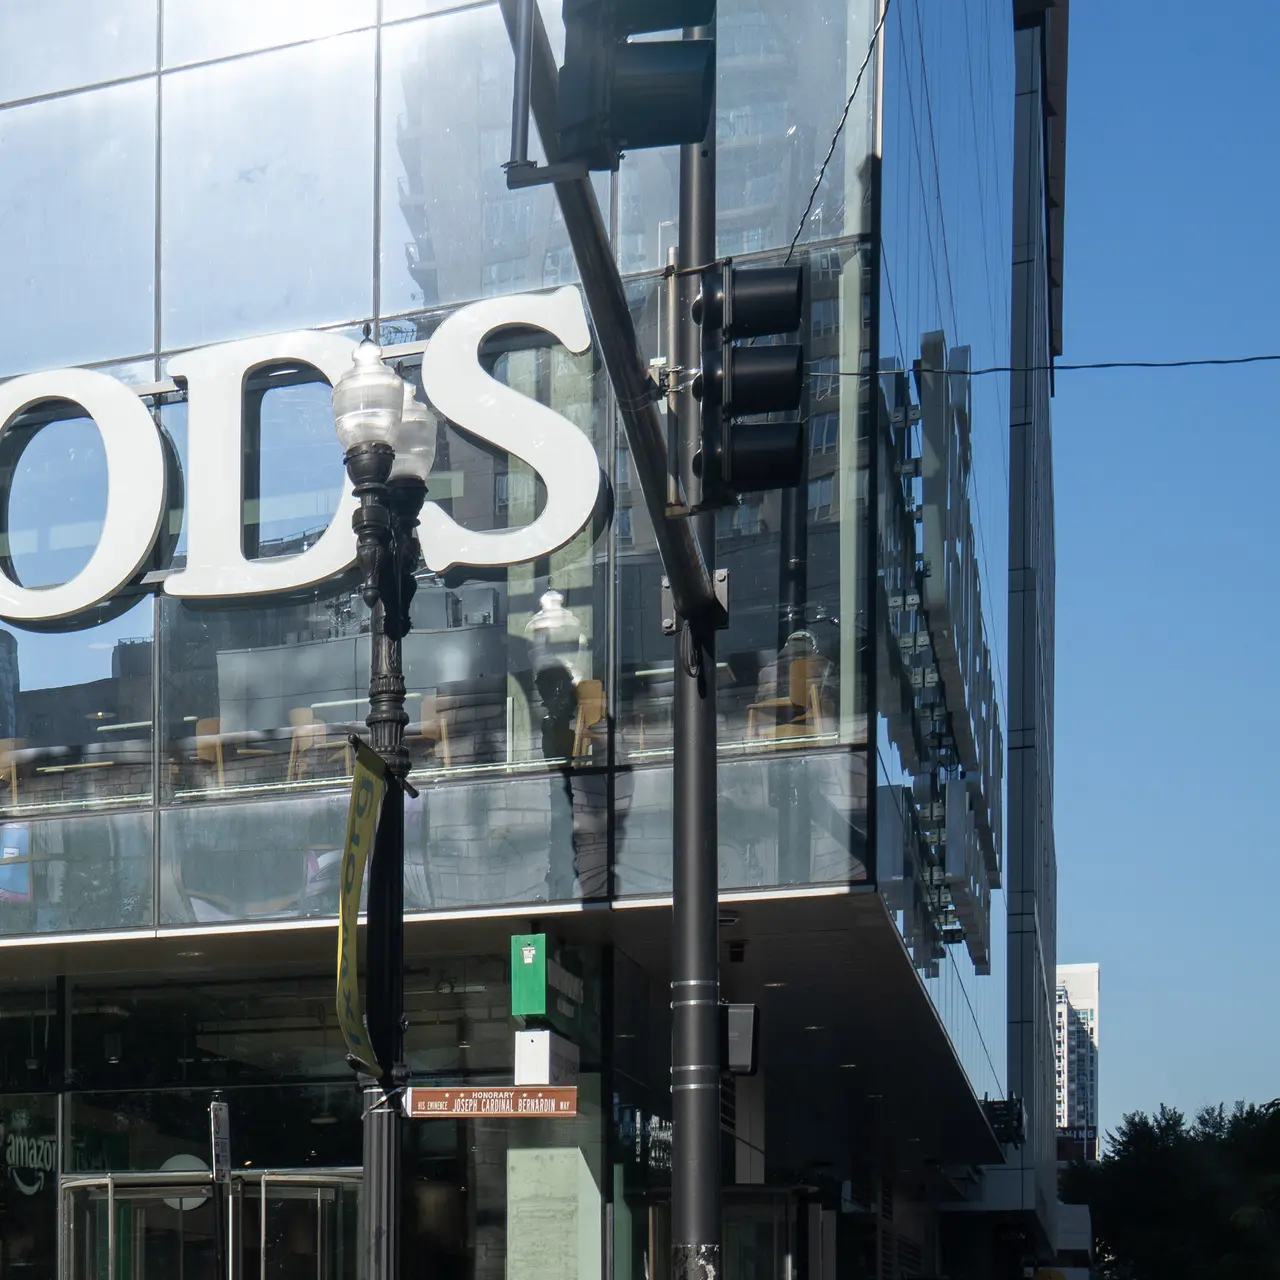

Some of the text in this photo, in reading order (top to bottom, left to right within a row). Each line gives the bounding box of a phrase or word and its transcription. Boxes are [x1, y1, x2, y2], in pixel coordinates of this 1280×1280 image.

[417, 1099, 570, 1112] HIS EMINENCE JOSEPH CARDINAL BERNARDIN WAY
